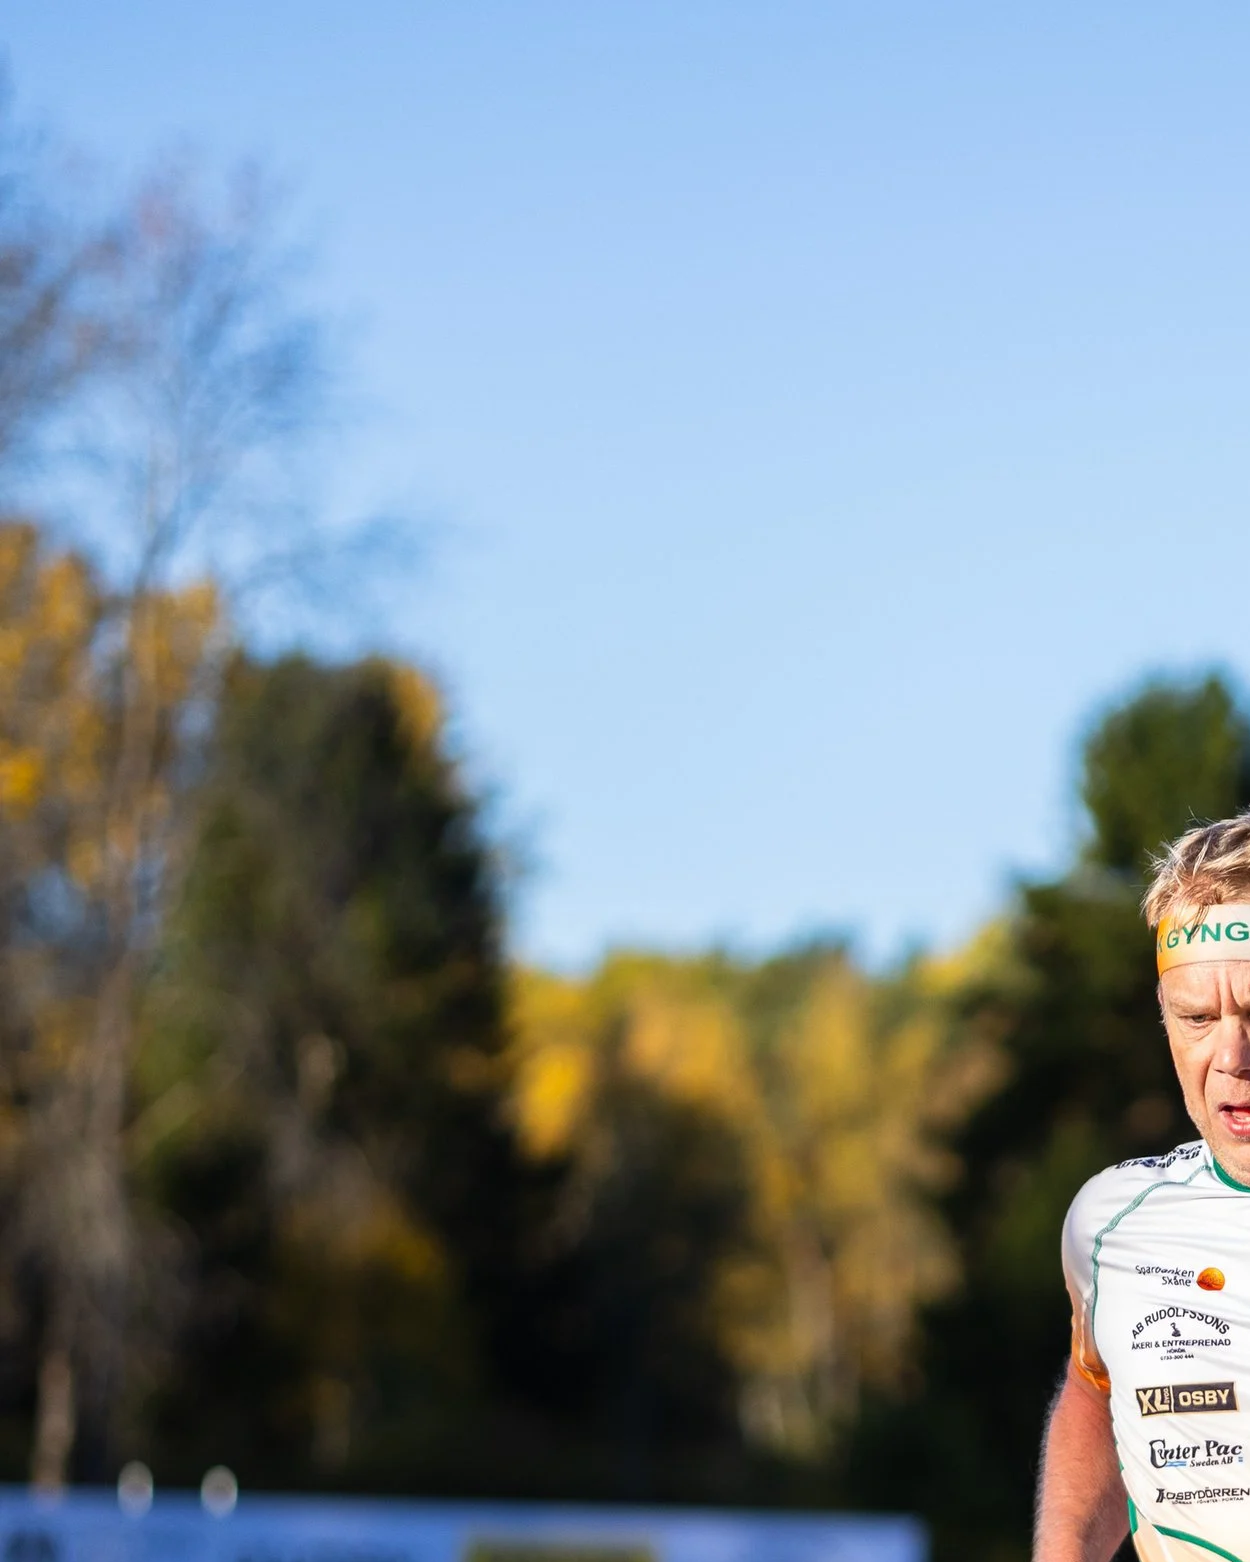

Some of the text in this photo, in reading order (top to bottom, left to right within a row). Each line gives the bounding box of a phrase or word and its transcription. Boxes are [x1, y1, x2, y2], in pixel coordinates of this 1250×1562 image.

[1161, 1275, 1192, 1287] Skåne
[1131, 1306, 1230, 1340] AB RUDOLFSSONS
[1131, 1338, 1232, 1351] ÅKERI & ENTREPRENAD
[1138, 1388, 1170, 1415] XL
[1178, 1389, 1230, 1407] OSBY
[1204, 1439, 1243, 1457] Pac
[1189, 1456, 1234, 1468] Sweden AB
[1166, 1486, 1250, 1500] OSBYDÖRREN
